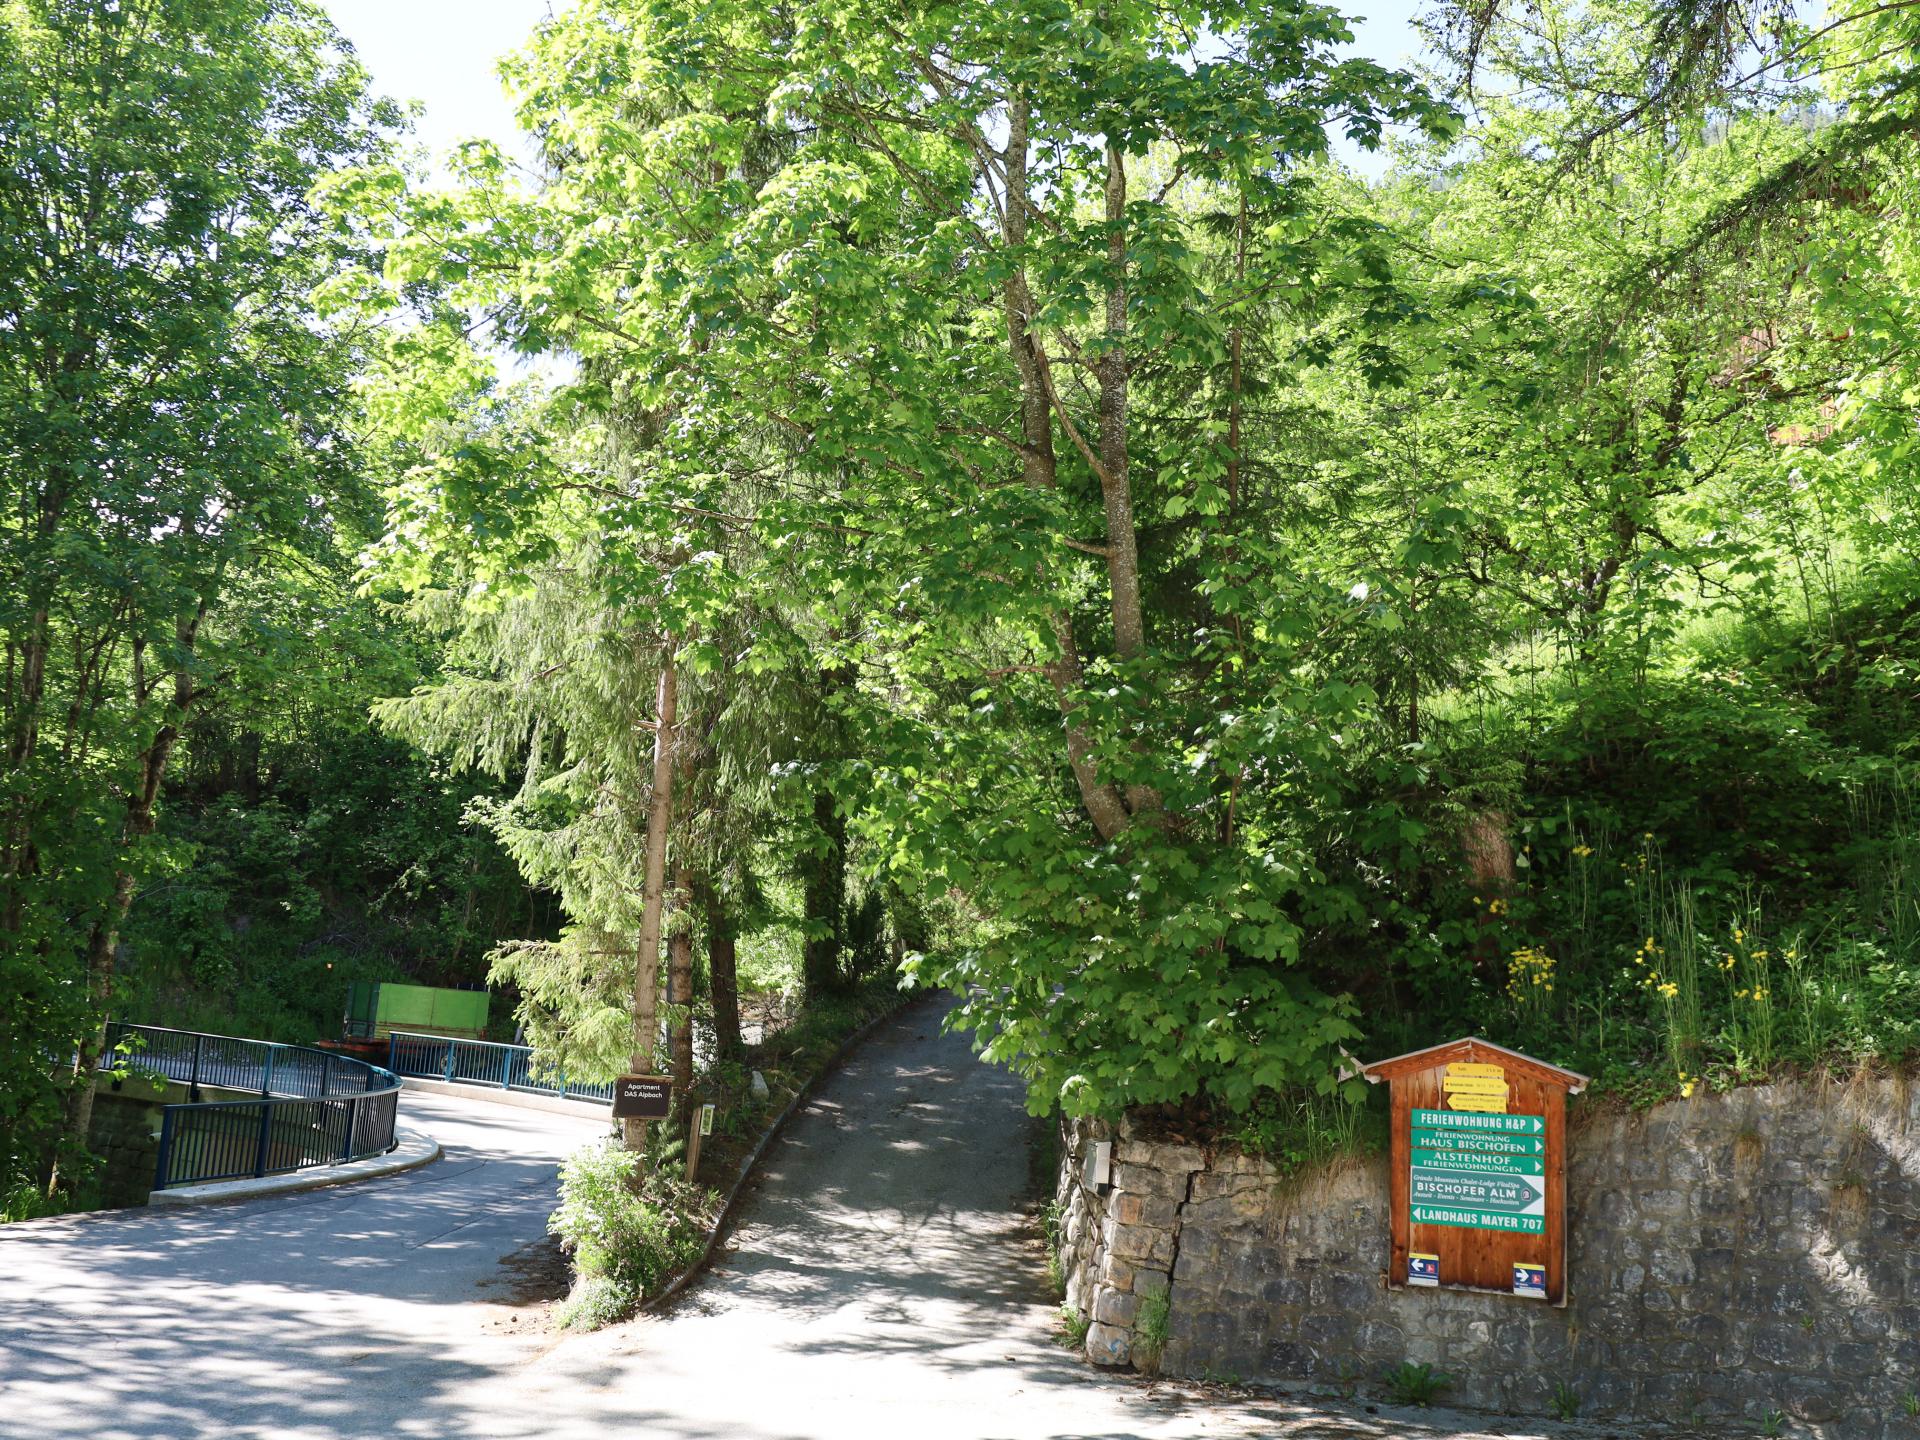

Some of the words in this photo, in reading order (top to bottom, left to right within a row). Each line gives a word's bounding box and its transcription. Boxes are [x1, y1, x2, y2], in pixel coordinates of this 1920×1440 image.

[628, 1083, 660, 1091] Apartment
[638, 1091, 663, 1099] Alpbach
[1421, 1113, 1502, 1129] FERIENWOHNUNG
[1505, 1118, 1526, 1130] H&P
[1435, 1131, 1510, 1143] FERIENWOHNUNG
[1420, 1137, 1452, 1148] HAUS
[1458, 1140, 1526, 1153] BISCHOFEN
[1433, 1151, 1511, 1165] ALSTENHOF
[1423, 1160, 1522, 1173] FERIENWOHNUNGEN
[1417, 1182, 1485, 1197] BISCHOFER
[1490, 1187, 1516, 1199] ALM
[1422, 1209, 1477, 1224] LANDHAUS
[1481, 1214, 1518, 1228] MAYER
[1522, 1218, 1543, 1230] 707
